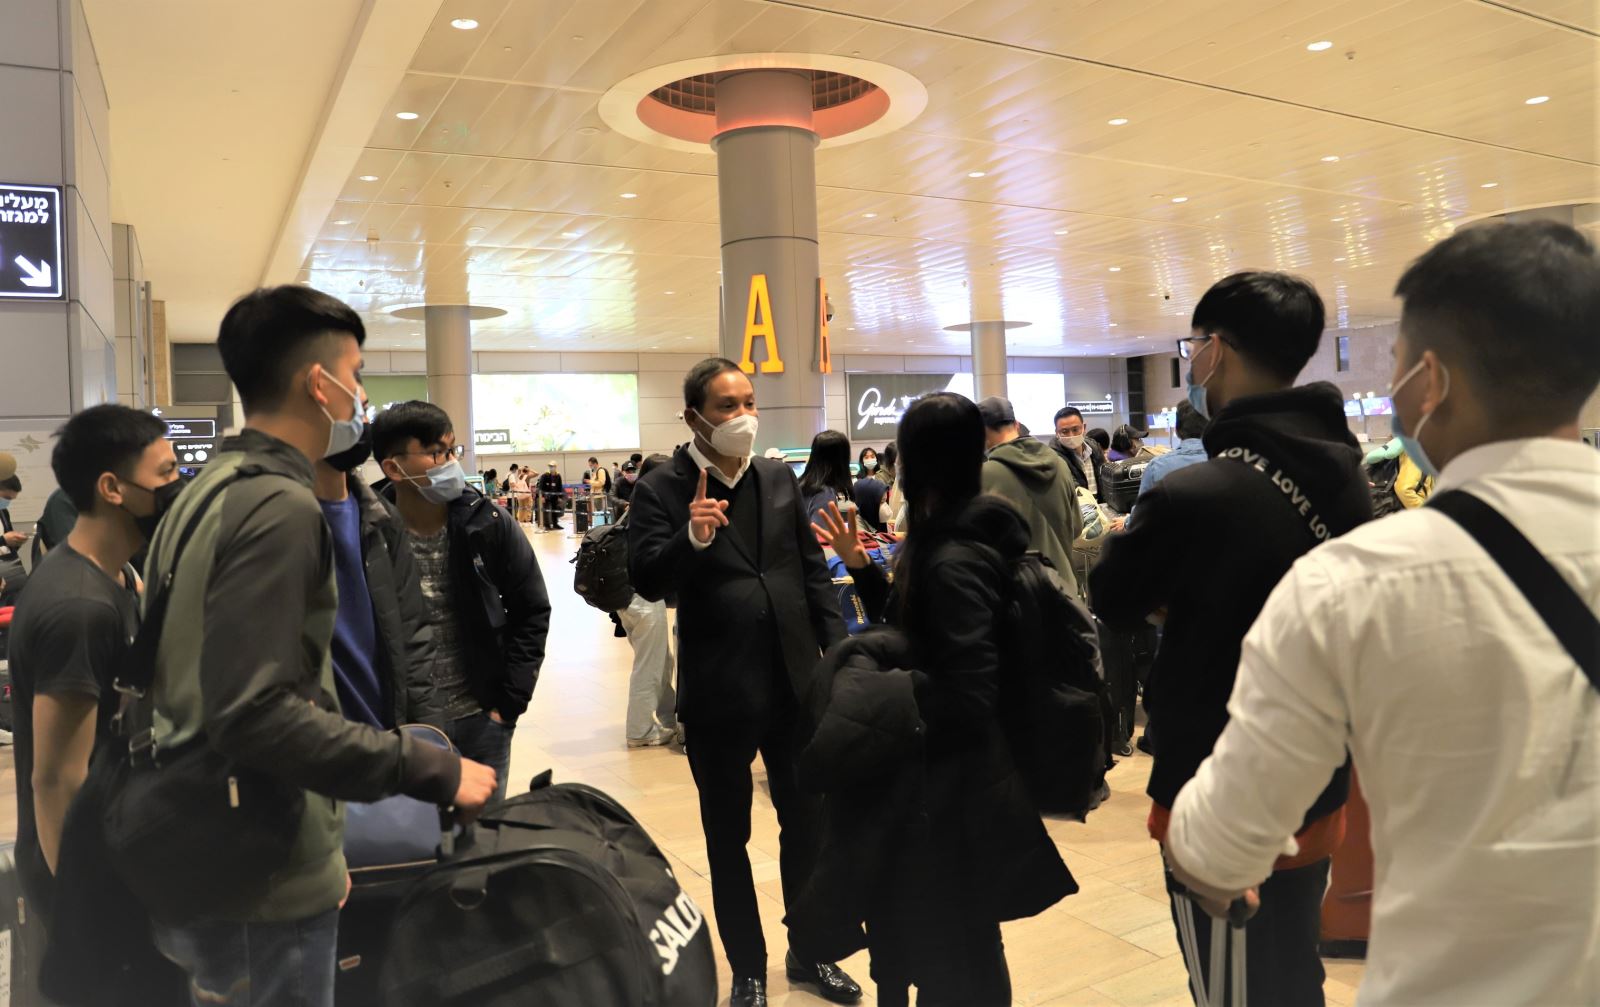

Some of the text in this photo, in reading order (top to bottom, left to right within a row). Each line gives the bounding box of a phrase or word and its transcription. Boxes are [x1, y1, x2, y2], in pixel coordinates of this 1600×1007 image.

[738, 274, 785, 374] A
[1217, 447, 1270, 472] LOVE
[1271, 469, 1312, 516] LOVE
